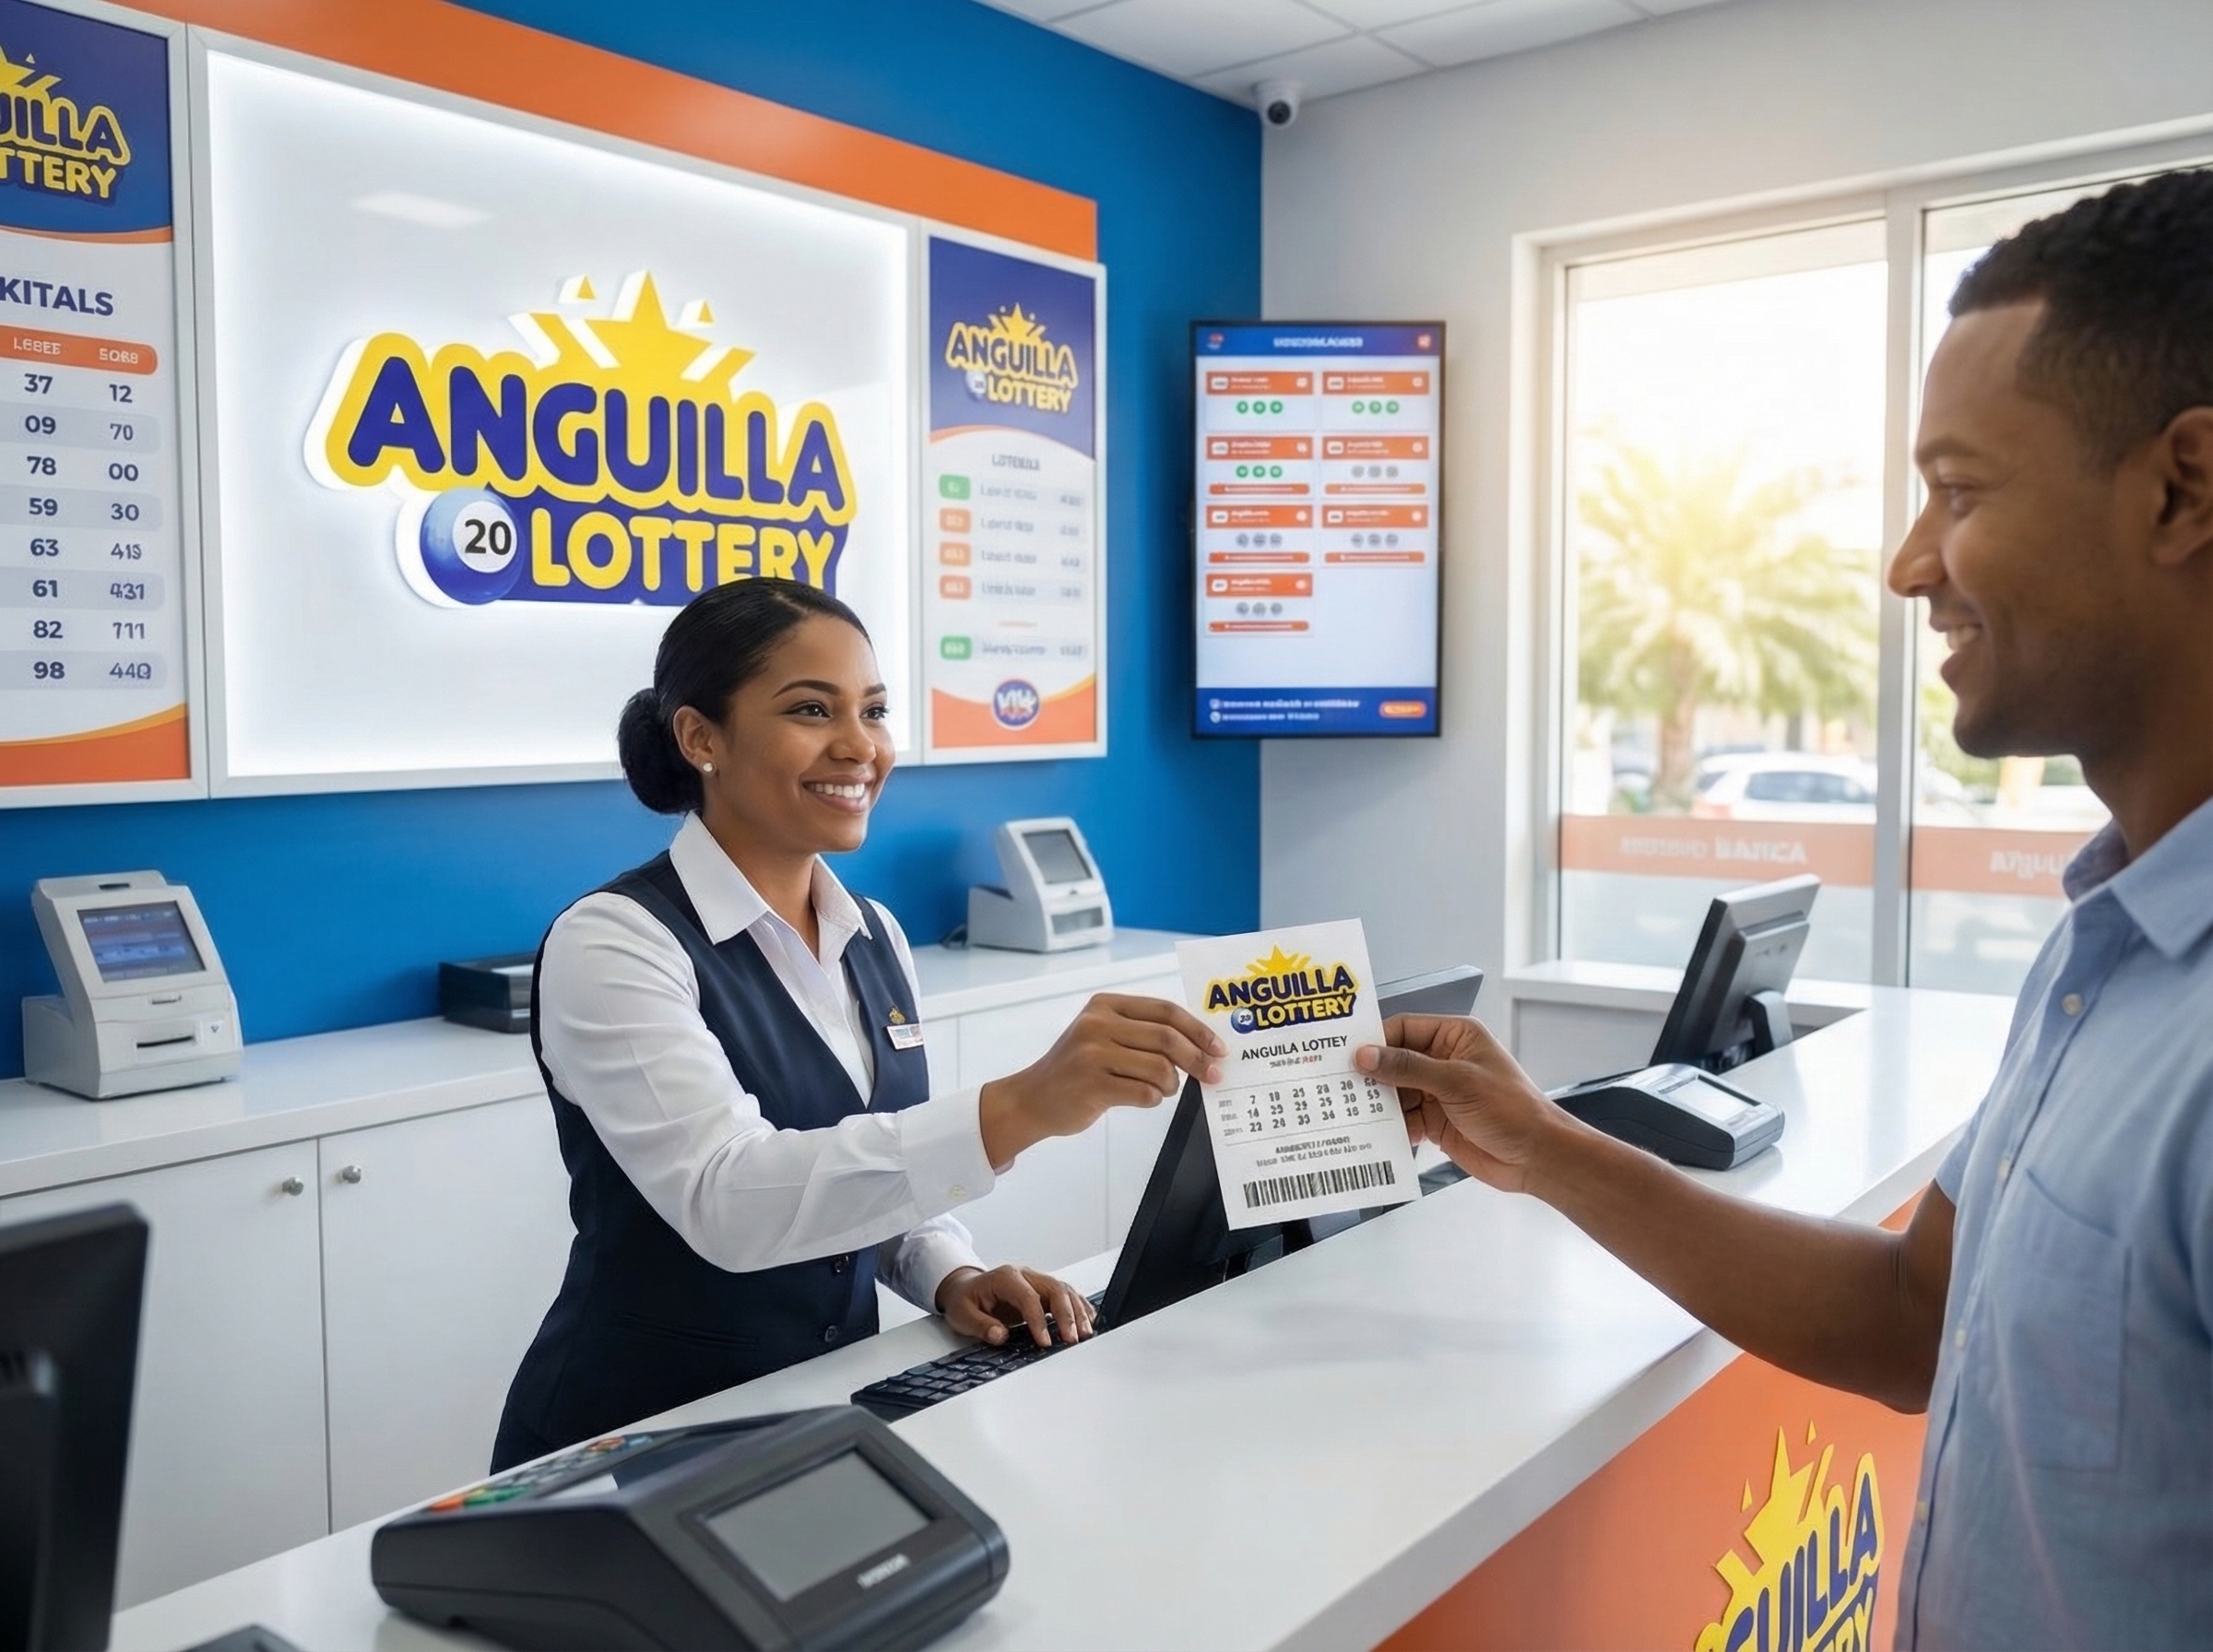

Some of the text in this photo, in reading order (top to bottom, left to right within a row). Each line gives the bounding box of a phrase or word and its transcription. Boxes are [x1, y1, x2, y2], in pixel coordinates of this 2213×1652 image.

[0, 92, 122, 158] ILLA
[951, 329, 1074, 383] ANGUILLA
[24, 373, 133, 403] 37 12
[988, 374, 1072, 413] LOTTERY
[25, 415, 134, 441] 09 70
[347, 356, 846, 513] ANGUILLA
[27, 456, 138, 481] 78 00
[29, 498, 139, 521] 59 30
[30, 538, 59, 557] 63
[464, 508, 834, 593] 20 LOTTERY
[32, 580, 58, 597] 61
[33, 620, 63, 639] 82
[33, 661, 65, 679] 98
[1209, 966, 1354, 1009] ANGUILLA
[1257, 996, 1353, 1026] LOTTERY
[1241, 1043, 1299, 1060] ANGUILA
